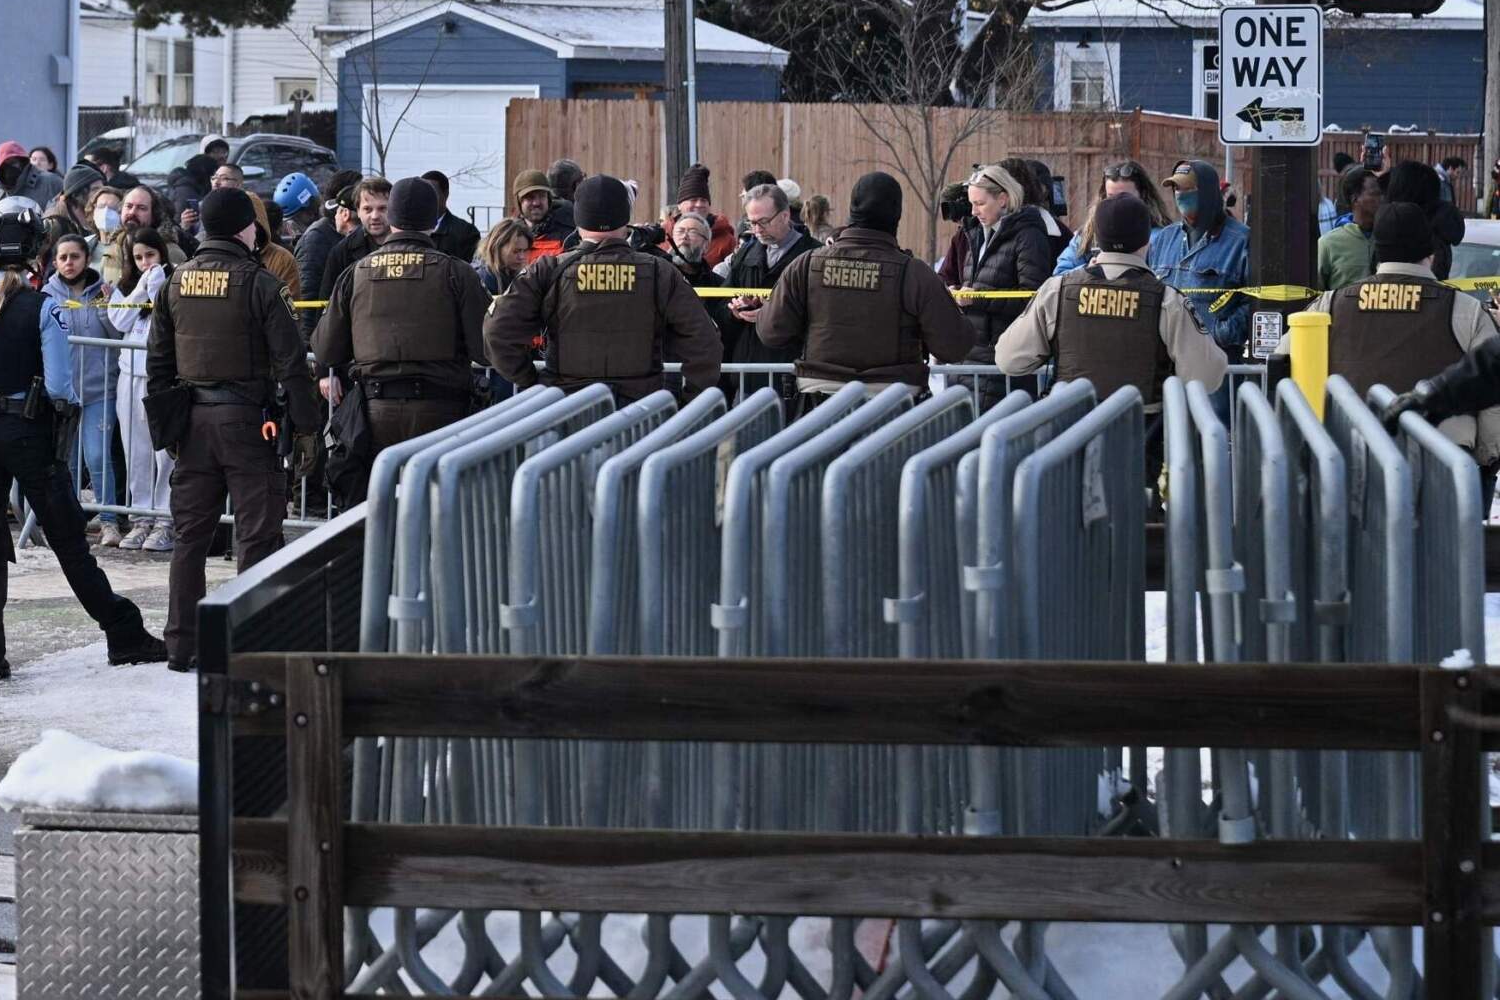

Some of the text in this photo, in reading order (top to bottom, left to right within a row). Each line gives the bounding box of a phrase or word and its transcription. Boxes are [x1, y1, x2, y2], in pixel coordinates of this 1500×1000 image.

[1235, 16, 1307, 48] ONE
[1232, 56, 1307, 87] WAY
[370, 253, 424, 267] SHERIFF
[387, 265, 404, 277] K9
[180, 271, 230, 296] SHERIFF
[577, 264, 636, 291] SHERIFF
[822, 266, 880, 289] SHERIFF
[1078, 287, 1140, 318] SHERIFF
[1358, 283, 1423, 311] SHERIFF
